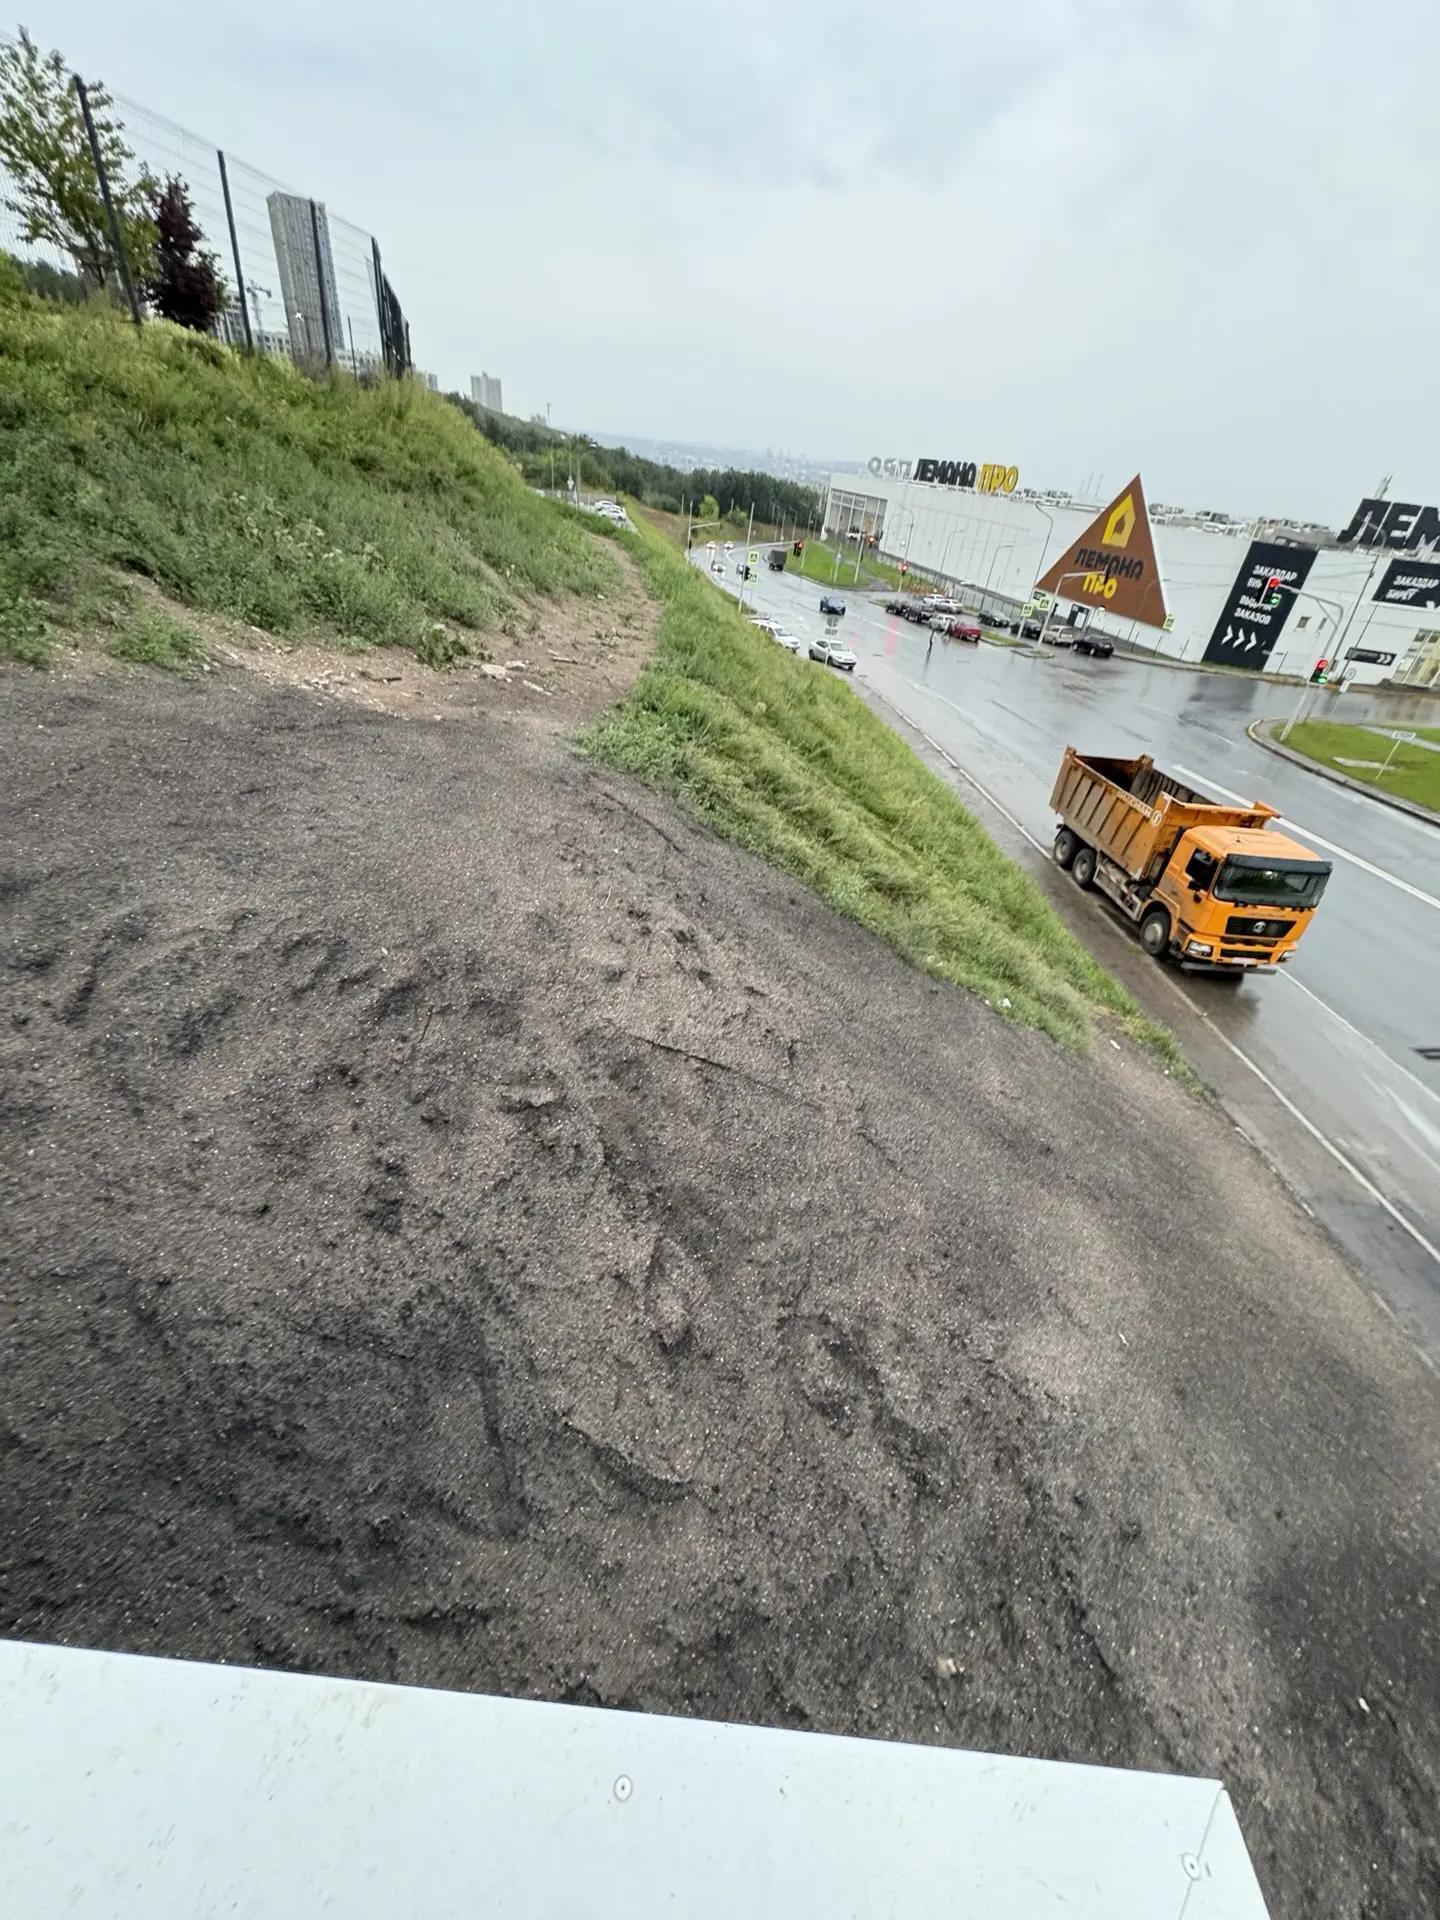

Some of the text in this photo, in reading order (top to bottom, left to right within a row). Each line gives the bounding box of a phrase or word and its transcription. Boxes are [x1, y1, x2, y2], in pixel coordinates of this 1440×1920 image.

[913, 458, 1019, 494] ЛЕМАНА ПРО
[1073, 547, 1144, 582] ЛЕМАНА
[1082, 573, 1117, 600] ПРО
